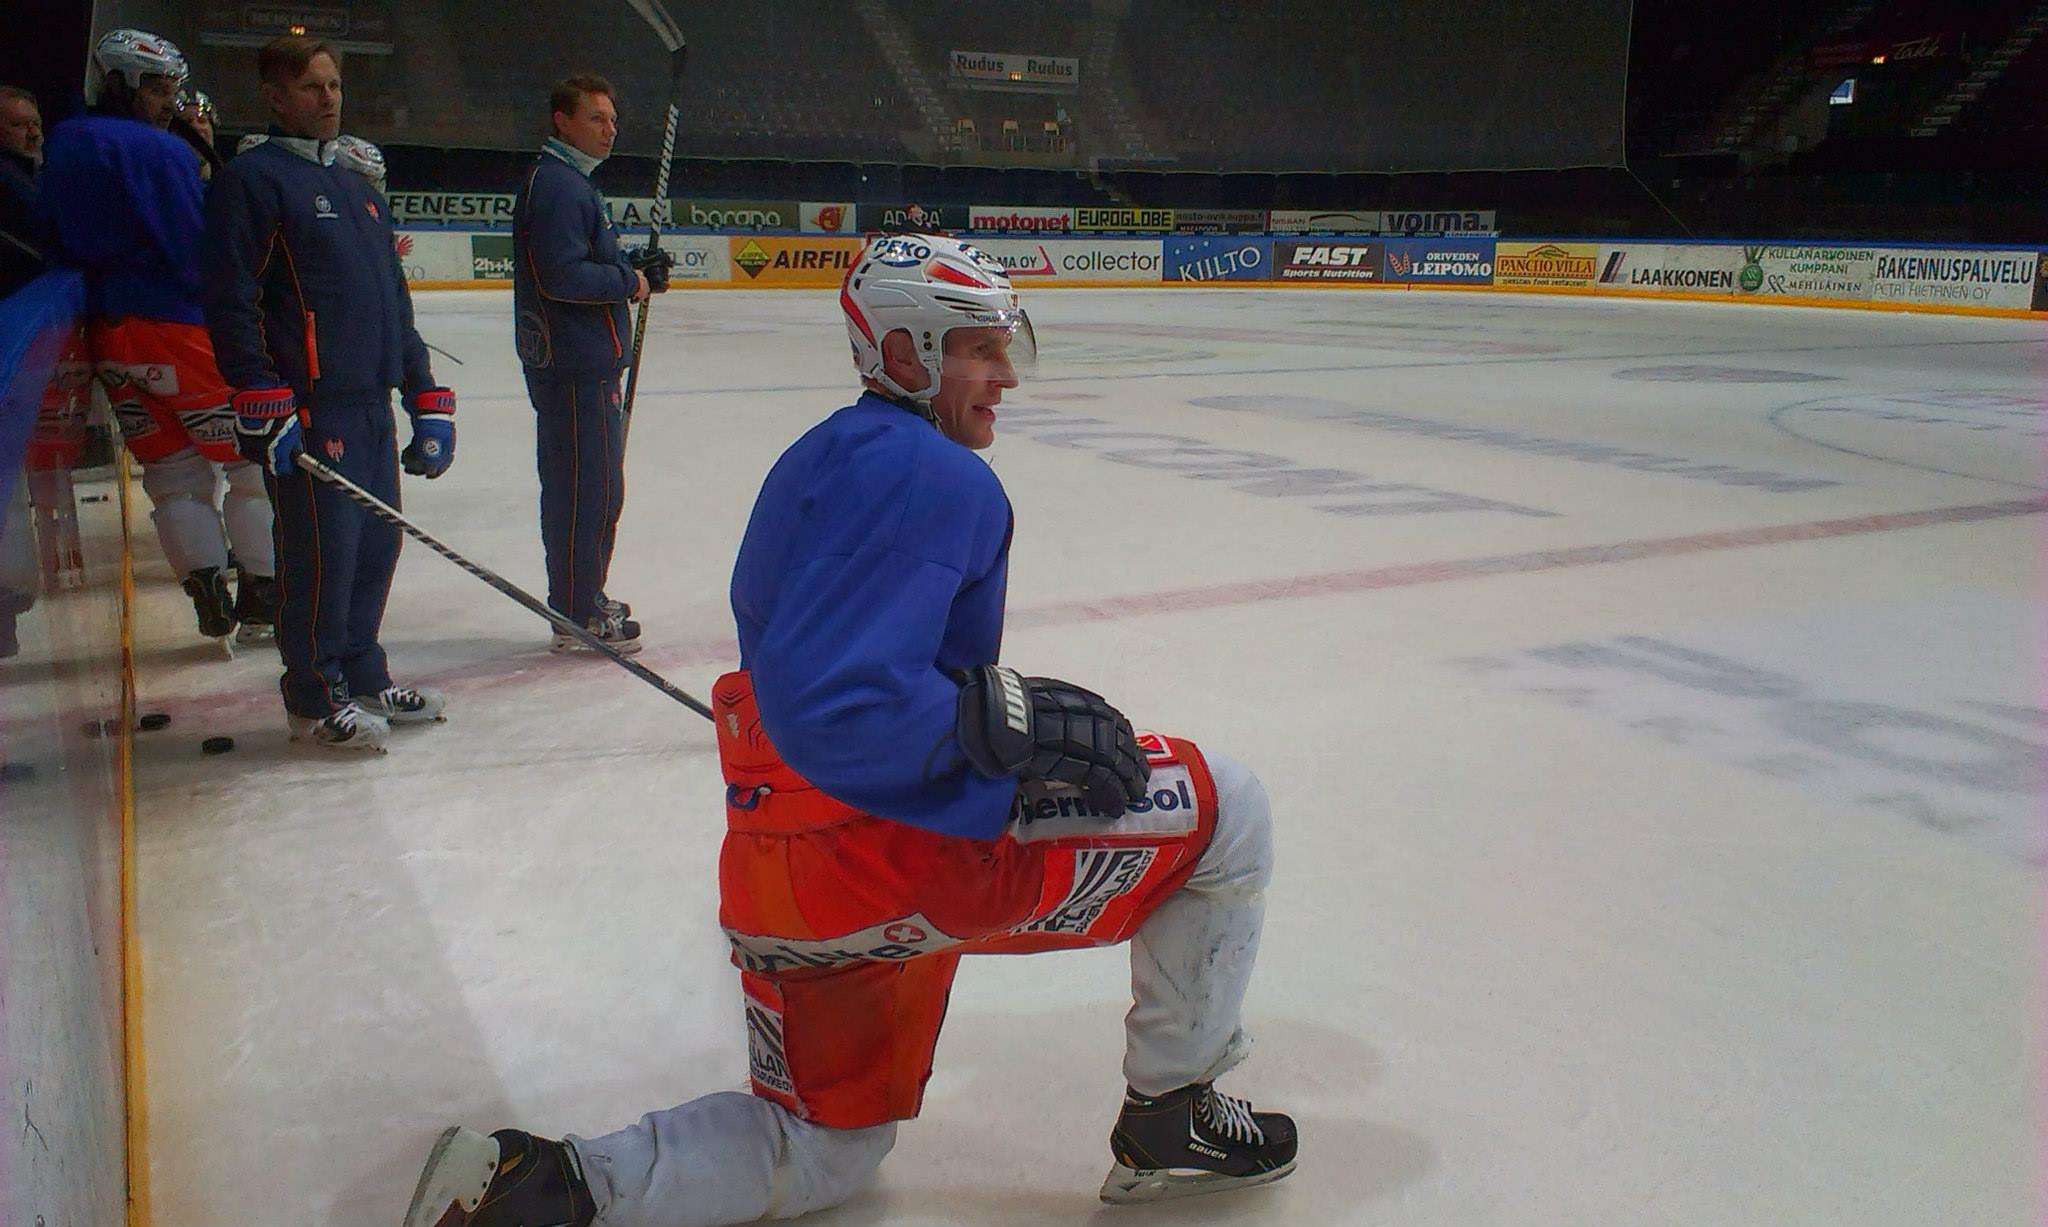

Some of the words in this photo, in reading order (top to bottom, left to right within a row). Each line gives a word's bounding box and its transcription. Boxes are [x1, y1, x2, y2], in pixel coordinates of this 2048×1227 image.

[956, 54, 1004, 73] Rudus
[1027, 59, 1073, 76] Rudus
[973, 212, 1070, 230] motonet
[1078, 210, 1171, 227] EUROGLOBE
[1020, 256, 1037, 268] OY
[1063, 251, 1160, 270] collector
[1292, 246, 1368, 266] FAST
[1426, 252, 1480, 261] ORIVEDEN
[1768, 248, 1874, 261] KULLANARVOINEN
[1179, 246, 1261, 282] KIILTO
[1412, 262, 1492, 276] LEIPOMO
[1501, 260, 1552, 272] PANCHO
[1556, 261, 1592, 273] VILLA
[1790, 263, 1848, 274] KUMPPANI
[1876, 256, 2033, 284] RAKENNUSPALVELU
[1283, 269, 1319, 278] Sports
[1322, 269, 1373, 278] Nutrition
[1631, 268, 1733, 288] LAAKKONEN
[1908, 285, 1968, 299] HIETANEN
[1972, 287, 1991, 300] OY
